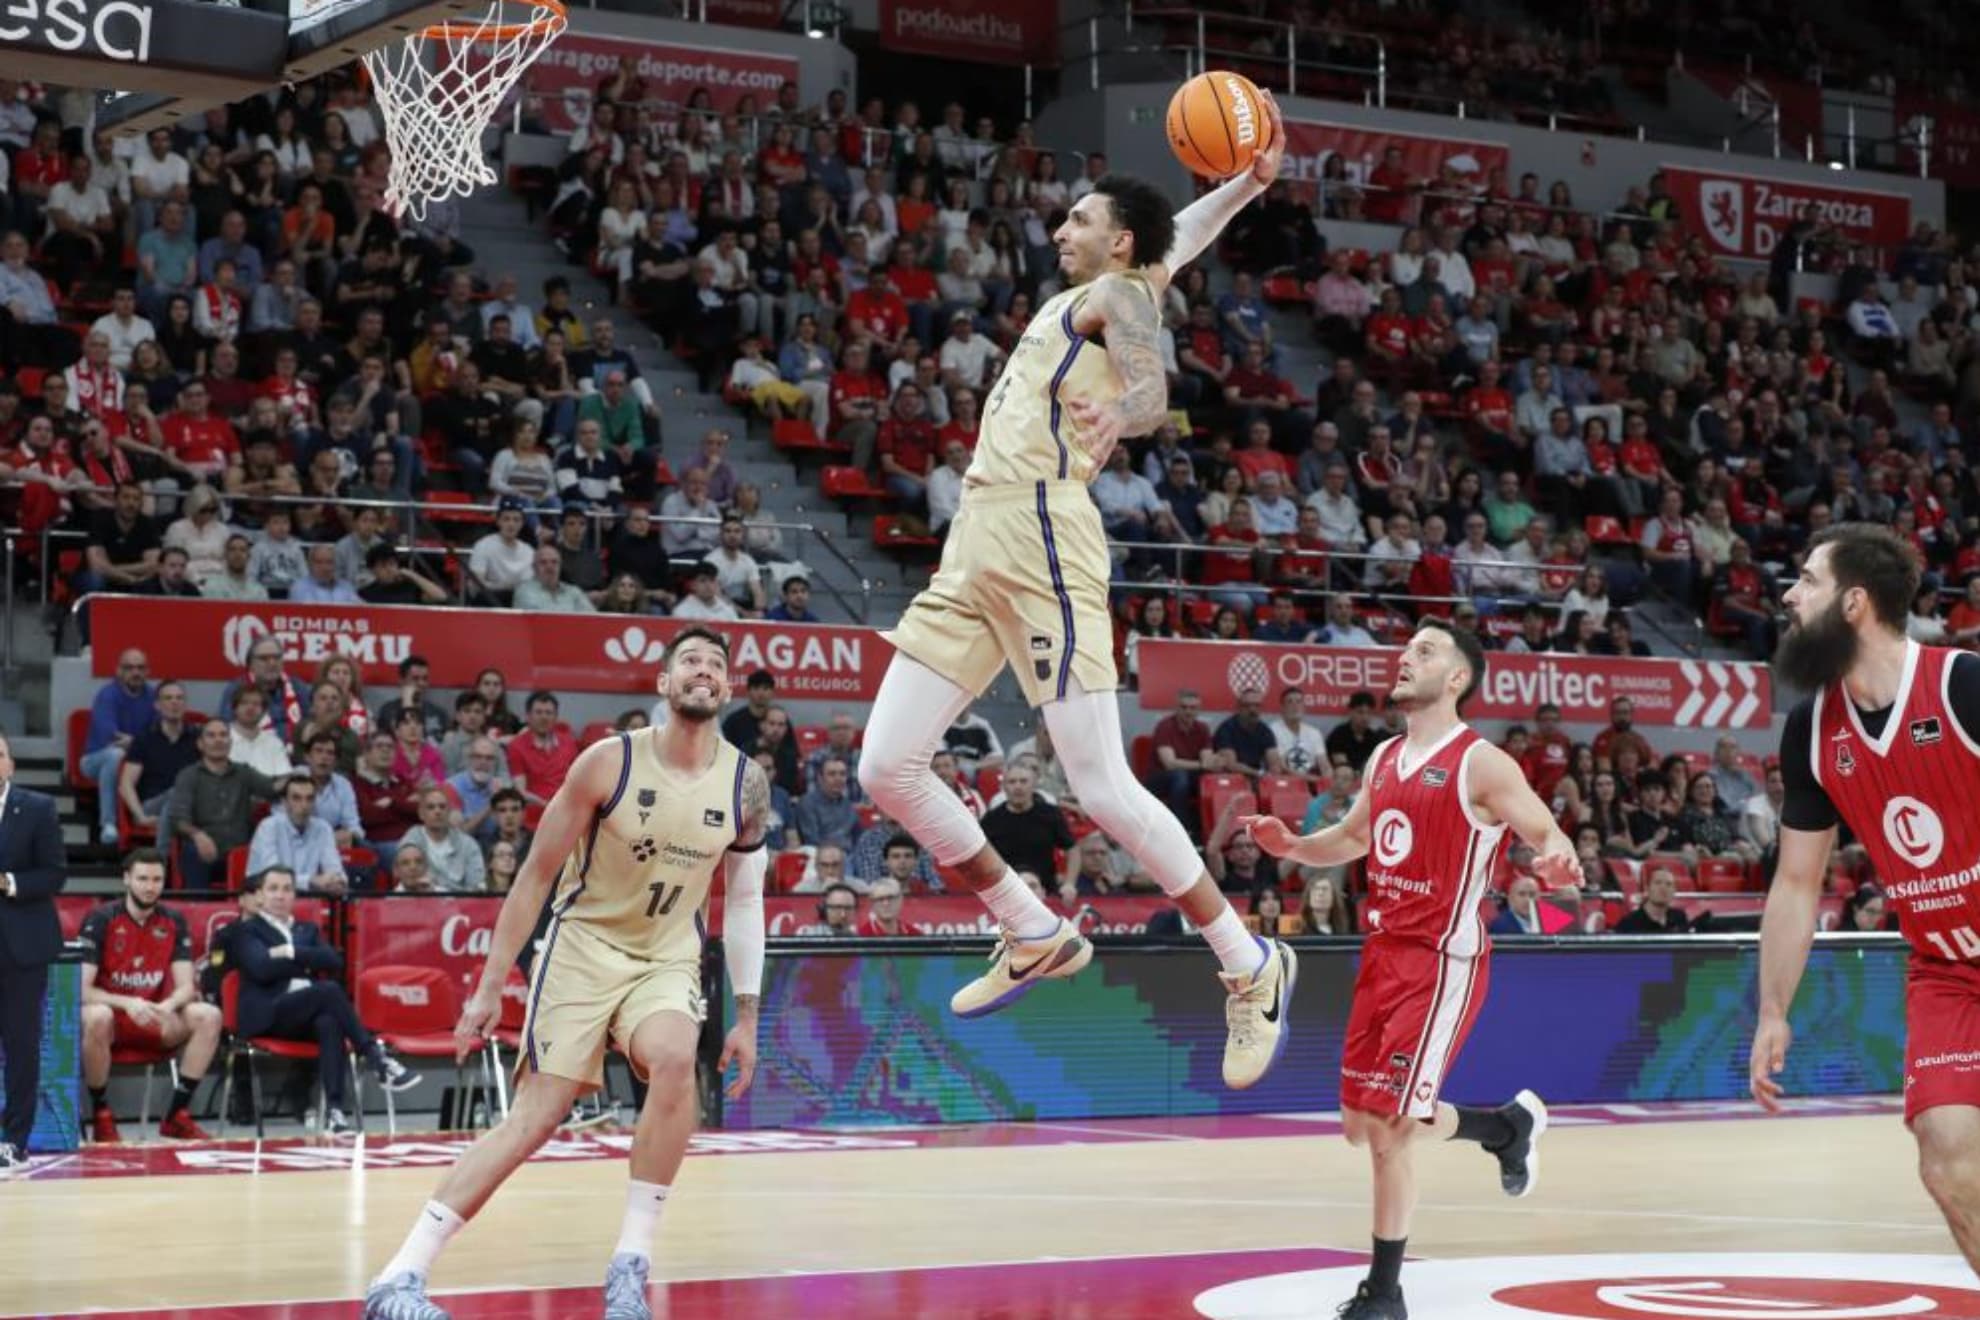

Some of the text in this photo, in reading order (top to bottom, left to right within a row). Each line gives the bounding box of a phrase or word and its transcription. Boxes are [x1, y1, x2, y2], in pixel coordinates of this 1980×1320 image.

[272, 615, 369, 633] BOMBAS
[720, 633, 862, 672] AGAN
[1277, 652, 1390, 688] ORBE
[795, 676, 862, 692] SEGUROS
[1481, 659, 1606, 707] levitec
[1925, 926, 1980, 961] 14
